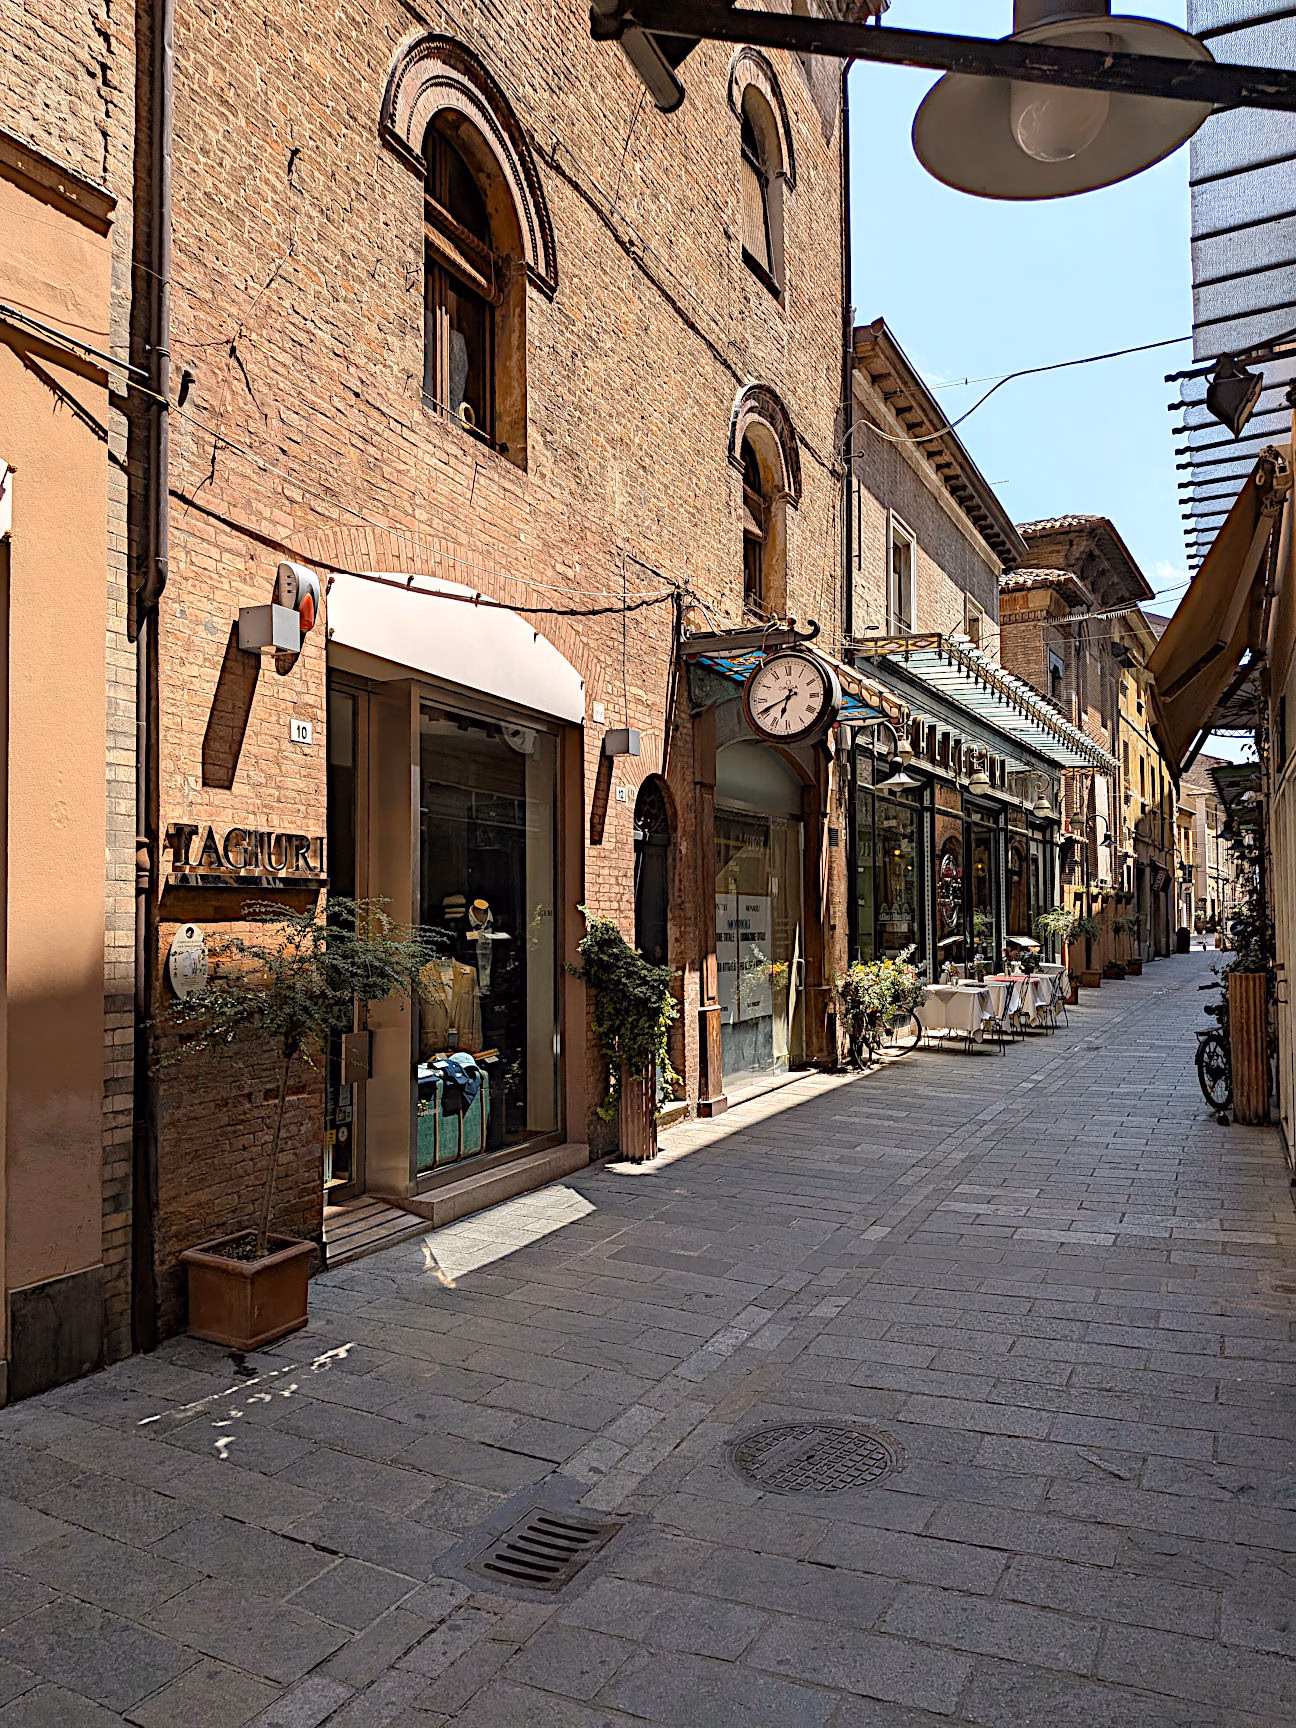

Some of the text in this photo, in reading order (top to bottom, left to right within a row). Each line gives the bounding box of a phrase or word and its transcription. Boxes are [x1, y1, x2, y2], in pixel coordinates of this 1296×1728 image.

[297, 724, 307, 740] 10
[618, 789, 625, 800] 12
[166, 822, 327, 872] TAGIURI
